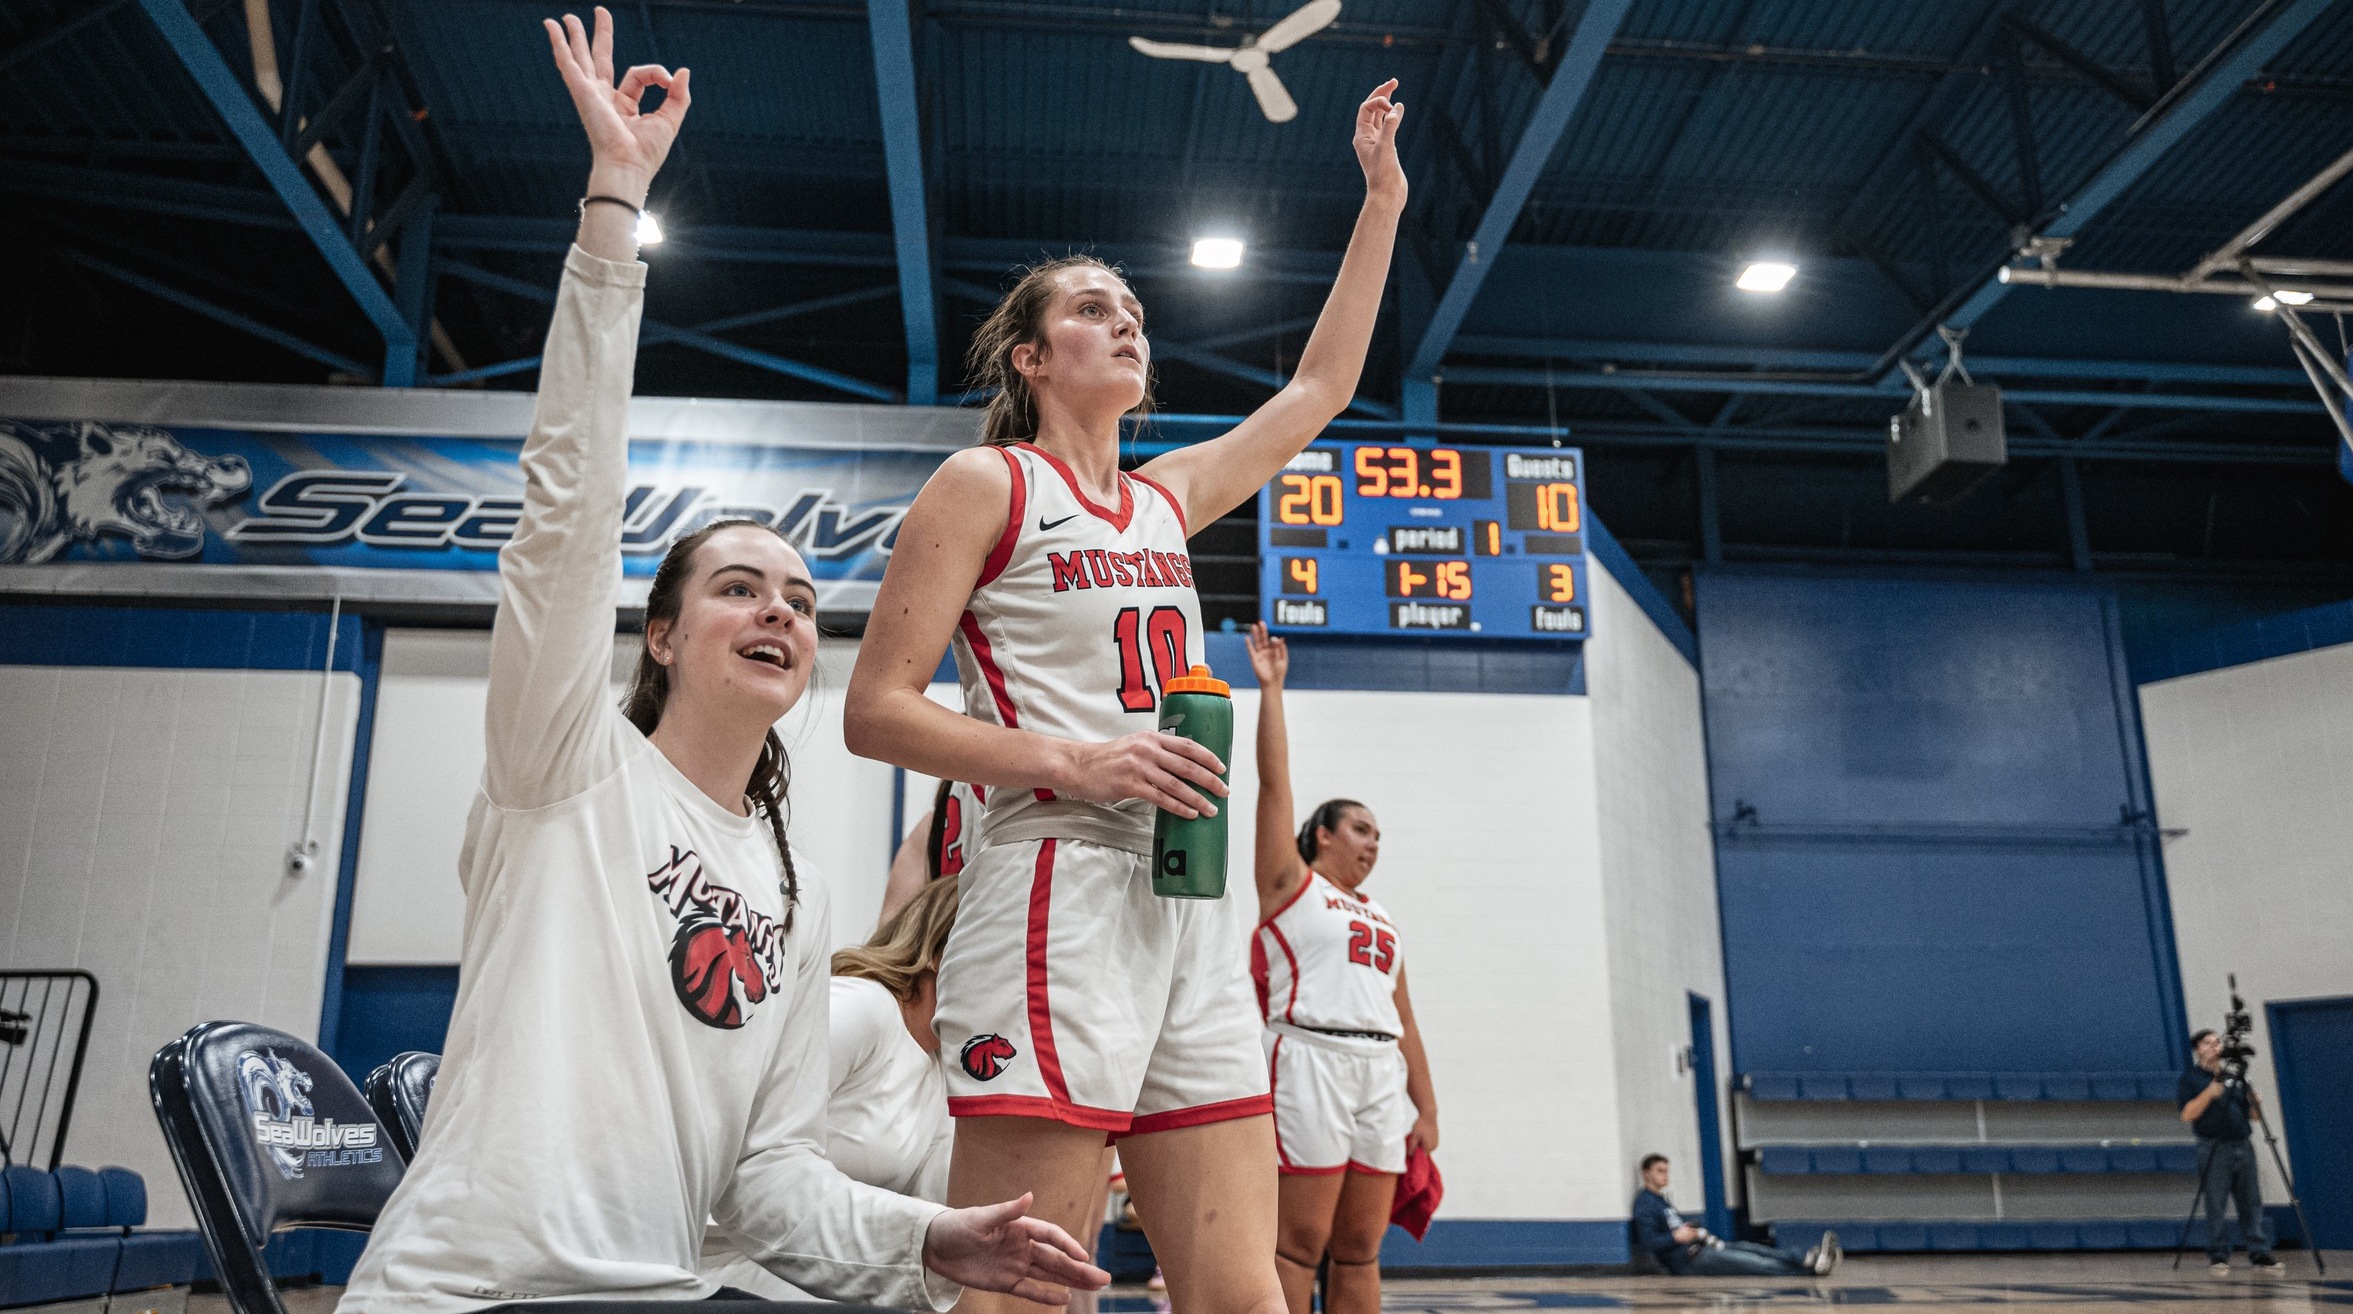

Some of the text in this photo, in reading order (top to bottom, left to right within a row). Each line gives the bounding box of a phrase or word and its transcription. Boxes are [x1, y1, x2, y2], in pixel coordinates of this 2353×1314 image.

[1355, 446, 1463, 498] 53.3
[1507, 453, 1575, 480] Guests
[1279, 474, 1344, 525] 20
[1536, 482, 1580, 533] 10
[1395, 527, 1459, 551] period
[1488, 521, 1501, 556] 1
[1291, 558, 1318, 594] 4
[1549, 563, 1575, 603] 3
[1277, 600, 1325, 624] fouls
[1398, 601, 1462, 630] player
[1536, 607, 1583, 632] fouls
[1113, 605, 1190, 713] 10
[1348, 920, 1396, 975] 25
[253, 1110, 377, 1150] SeaWolves
[307, 1147, 383, 1168] ATHLETICS
